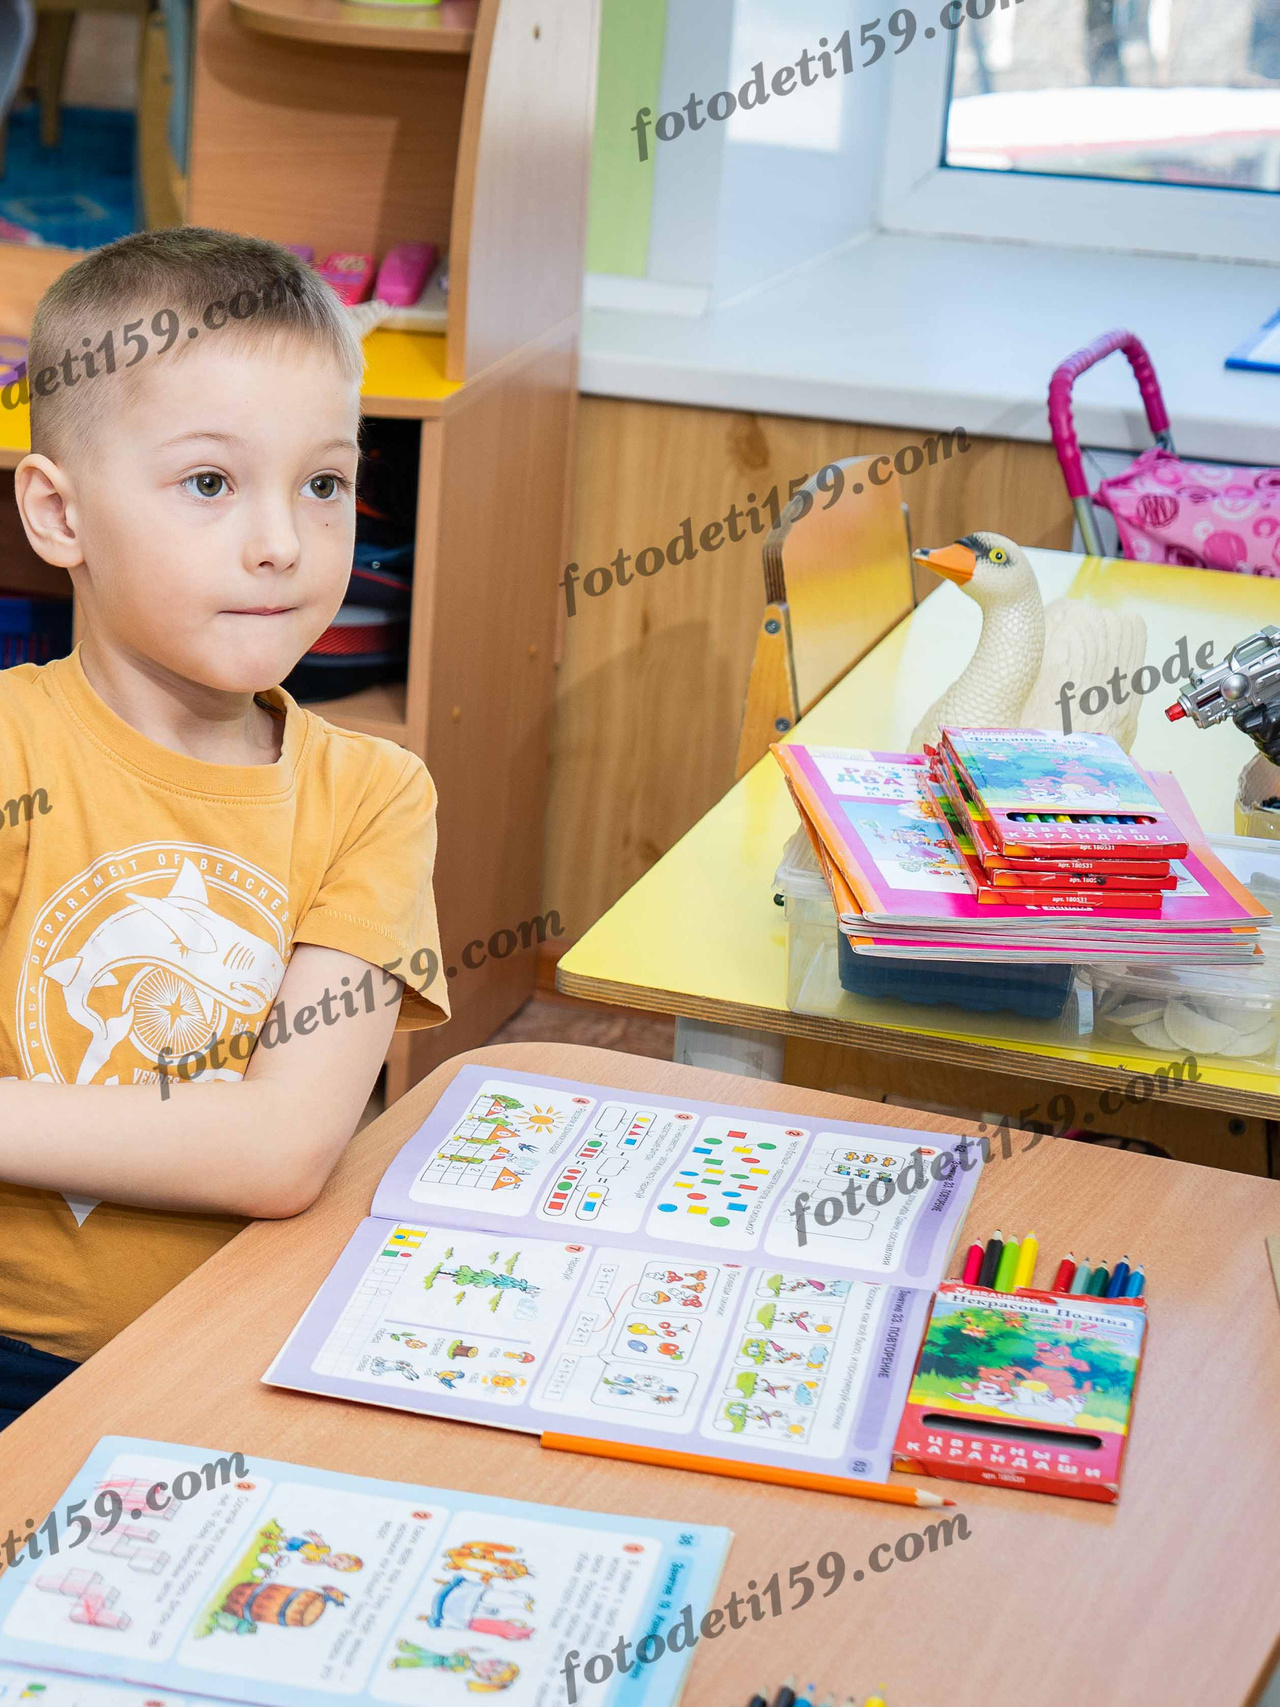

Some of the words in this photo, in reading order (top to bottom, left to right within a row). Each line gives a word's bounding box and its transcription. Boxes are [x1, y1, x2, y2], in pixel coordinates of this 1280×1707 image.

[1008, 831, 1169, 841] КАРАНДАШИ
[29, 859, 137, 965] DEPARTMET
[158, 852, 181, 867] OF
[199, 858, 290, 922] BEACHES
[952, 1294, 1050, 1315] Некрасова
[1056, 1308, 1129, 1328] Полина
[878, 1326, 902, 1378] ПОВТОРЕНИЕ
[850, 1459, 868, 1473] 63
[906, 1441, 1102, 1479] КАРАНДАШИ
[927, 1435, 1071, 1463] ЦВЕТНЫЕ
